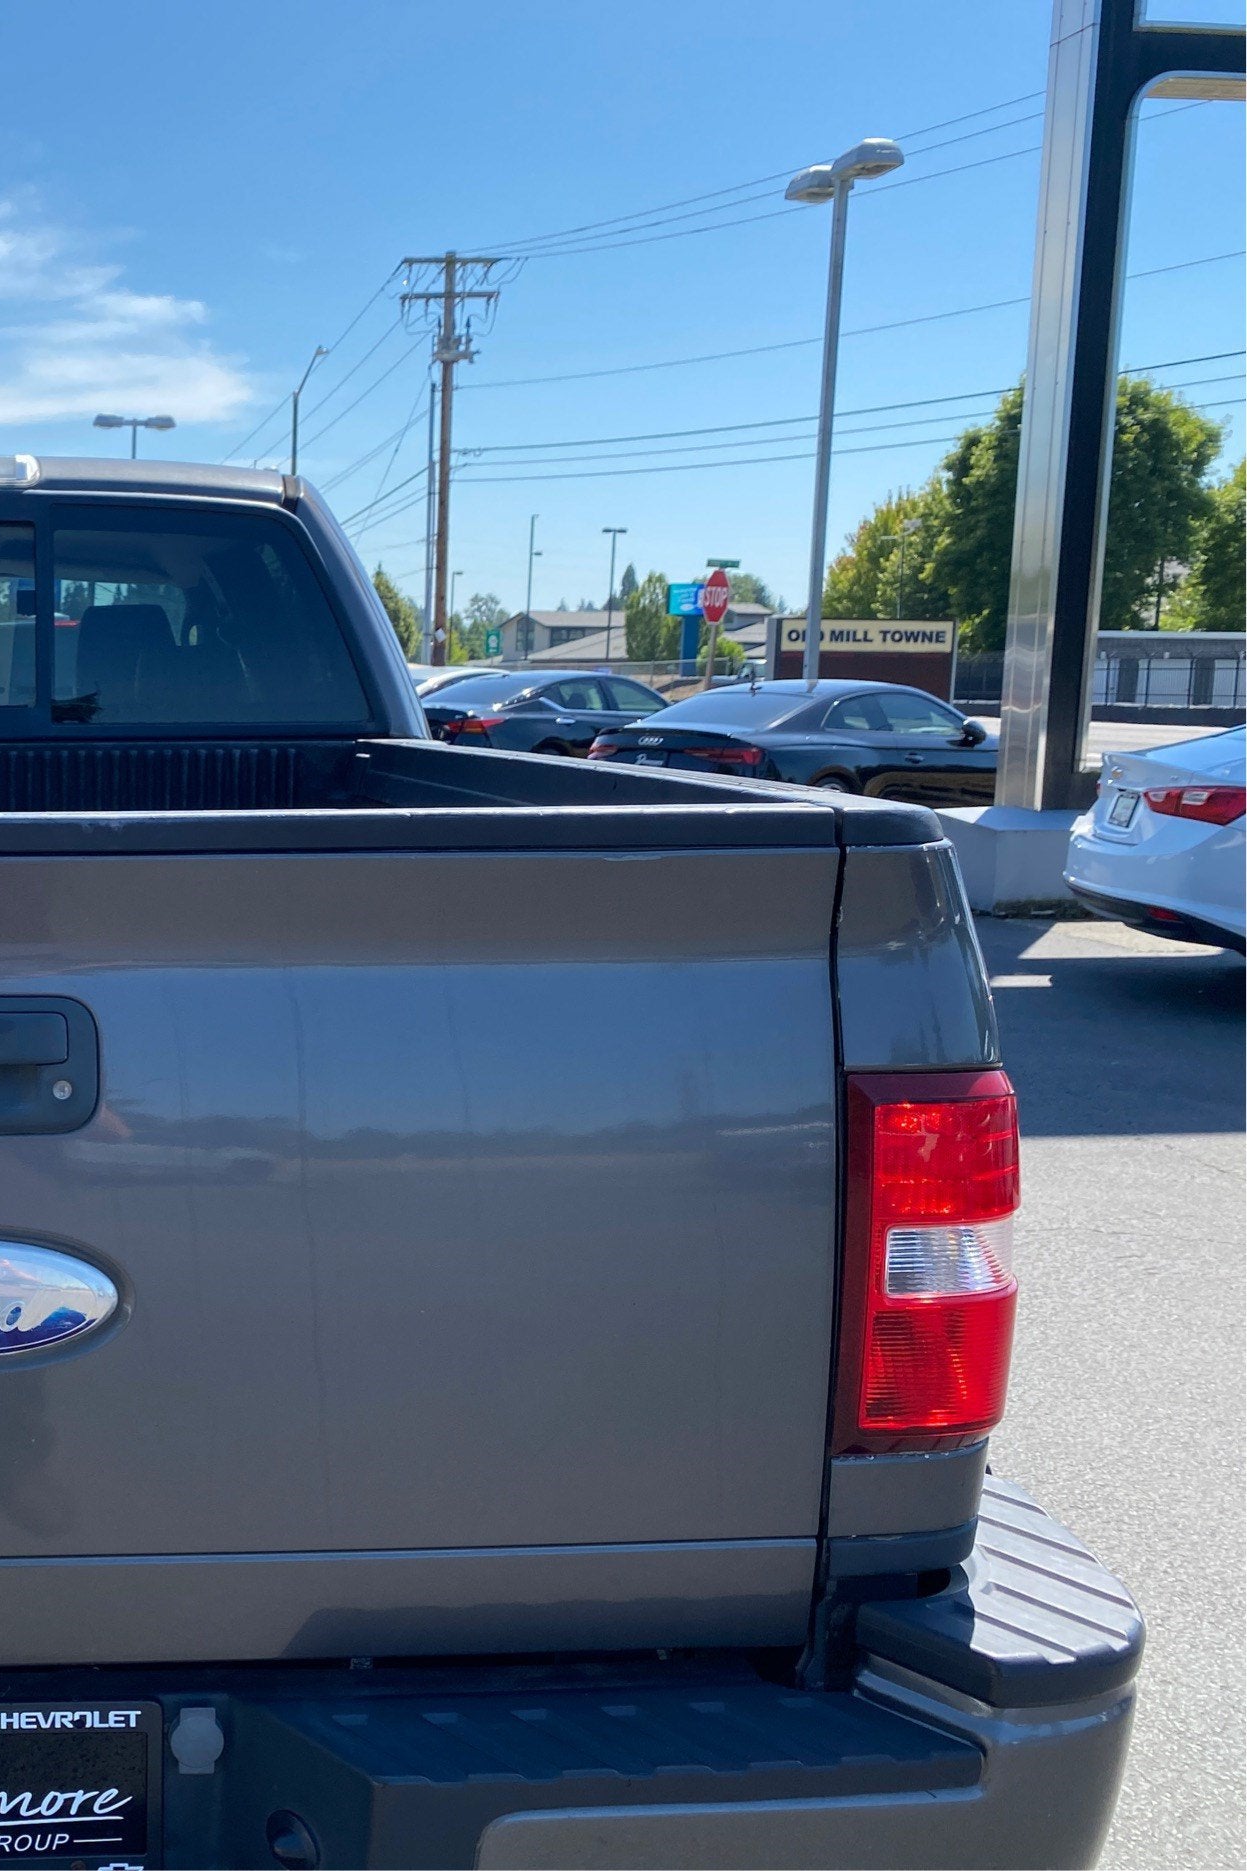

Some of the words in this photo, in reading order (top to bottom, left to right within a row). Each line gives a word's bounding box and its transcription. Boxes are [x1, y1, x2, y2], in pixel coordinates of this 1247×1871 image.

[704, 586, 727, 607] STOP
[829, 629, 873, 643] MILL
[879, 630, 946, 643] TOWNE
